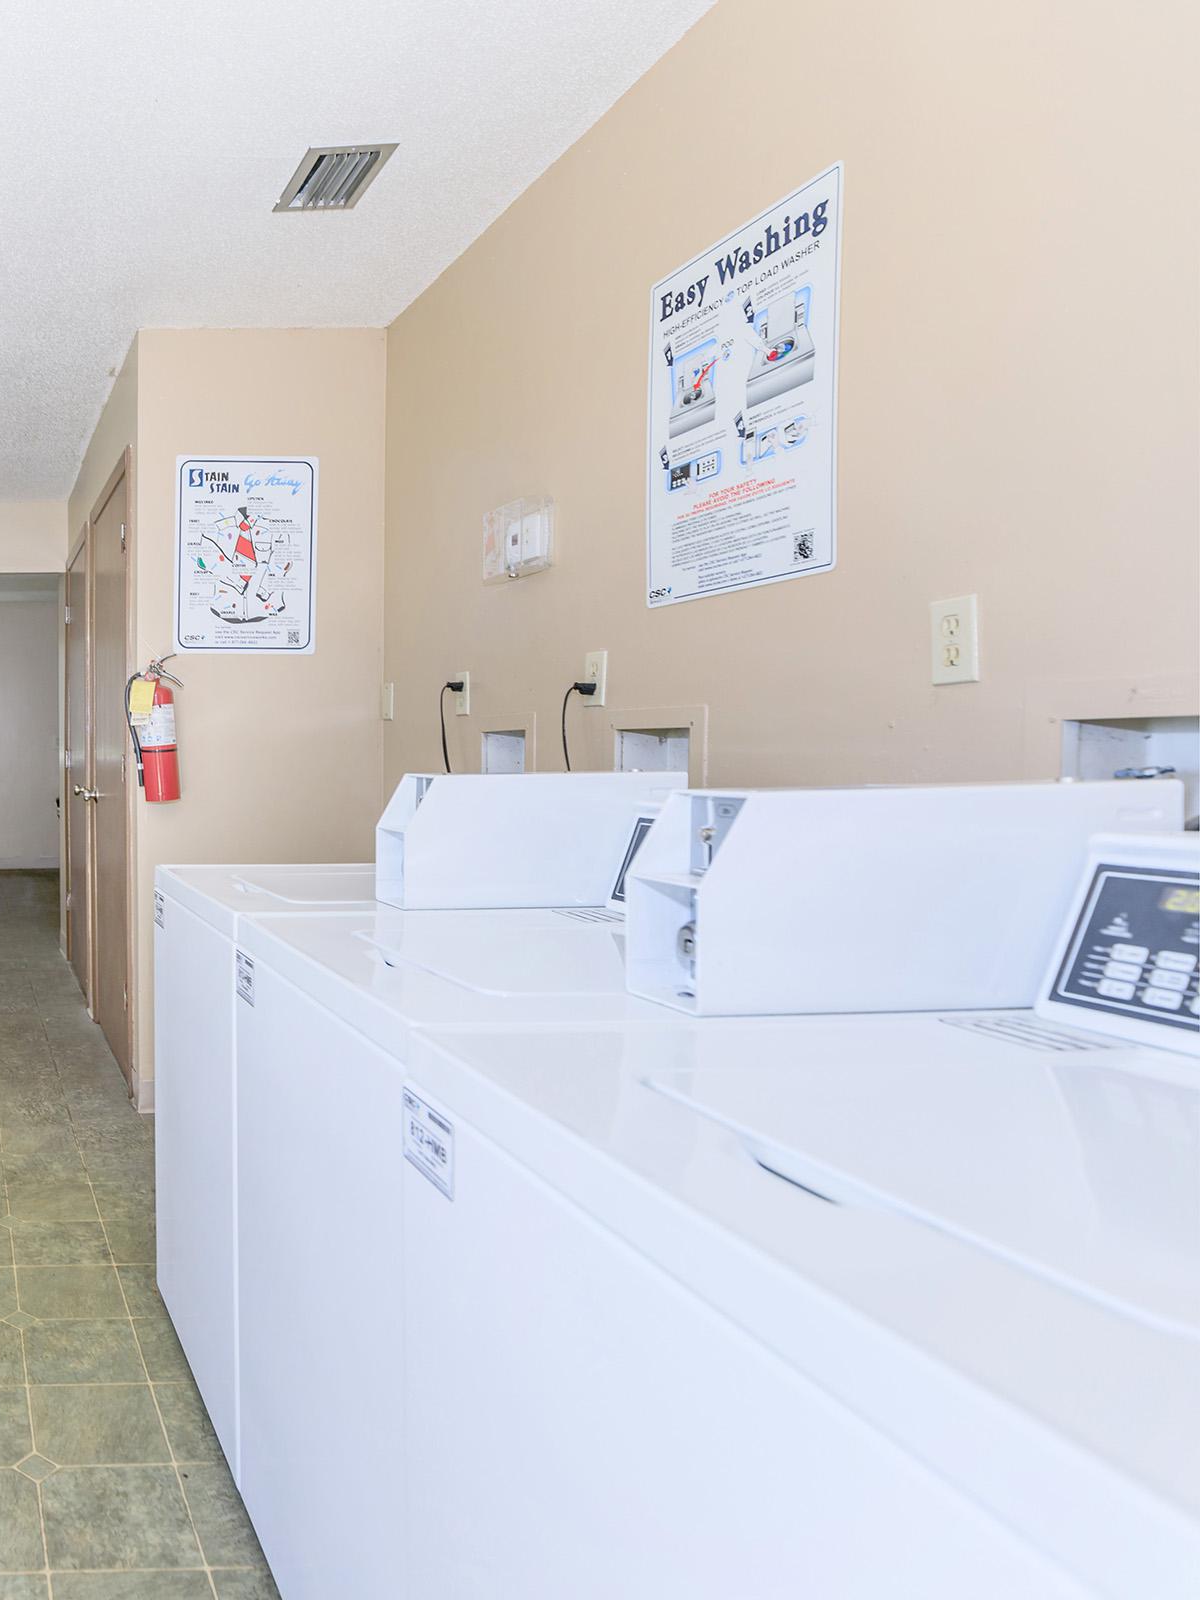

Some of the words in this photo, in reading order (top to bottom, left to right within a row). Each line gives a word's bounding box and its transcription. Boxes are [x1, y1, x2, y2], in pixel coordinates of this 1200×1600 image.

[660, 275, 710, 322] Easy
[714, 199, 829, 285] Washing
[736, 280, 753, 296] TOP
[755, 264, 779, 286] LOAD
[780, 240, 820, 269] WASHER
[209, 483, 239, 493] STAIN
[649, 588, 666, 599] CSC
